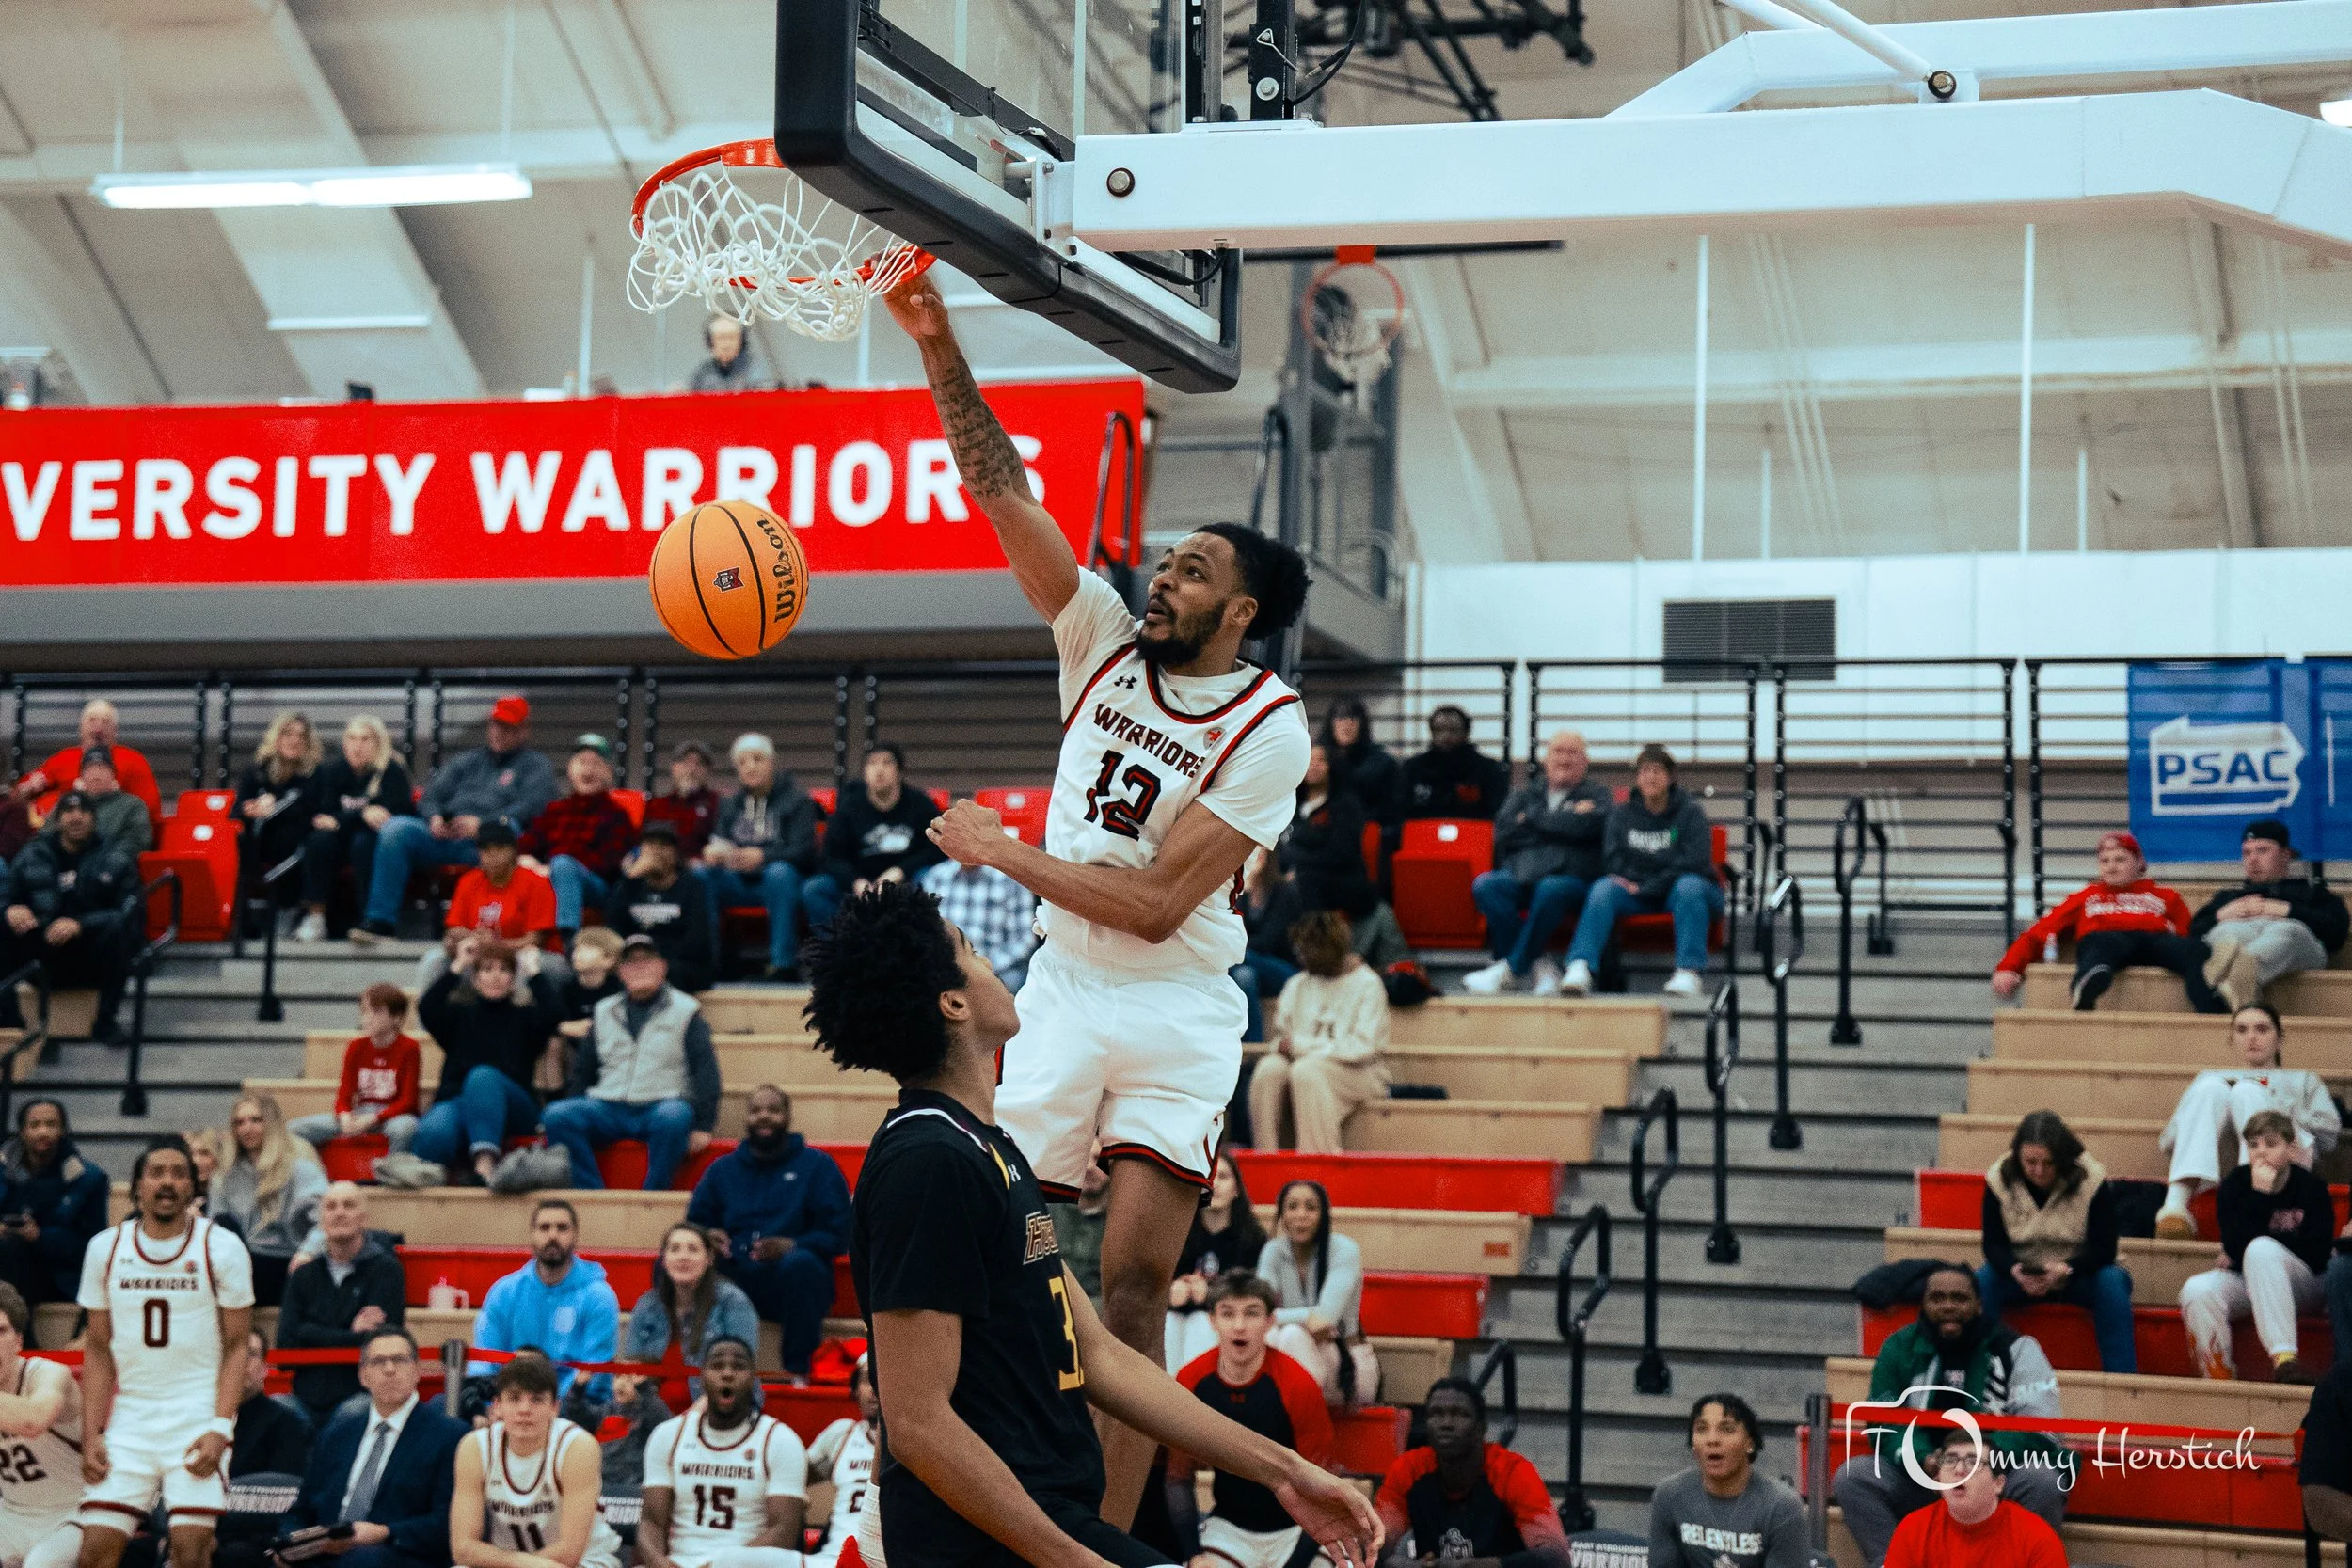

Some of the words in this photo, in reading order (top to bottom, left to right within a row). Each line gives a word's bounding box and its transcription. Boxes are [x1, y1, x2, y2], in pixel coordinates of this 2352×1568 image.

[756, 516, 796, 624] Wilson
[2158, 750, 2290, 785] PSAC
[1083, 749, 1162, 842] 12
[143, 1298, 170, 1348] 0
[693, 1484, 736, 1530] 15
